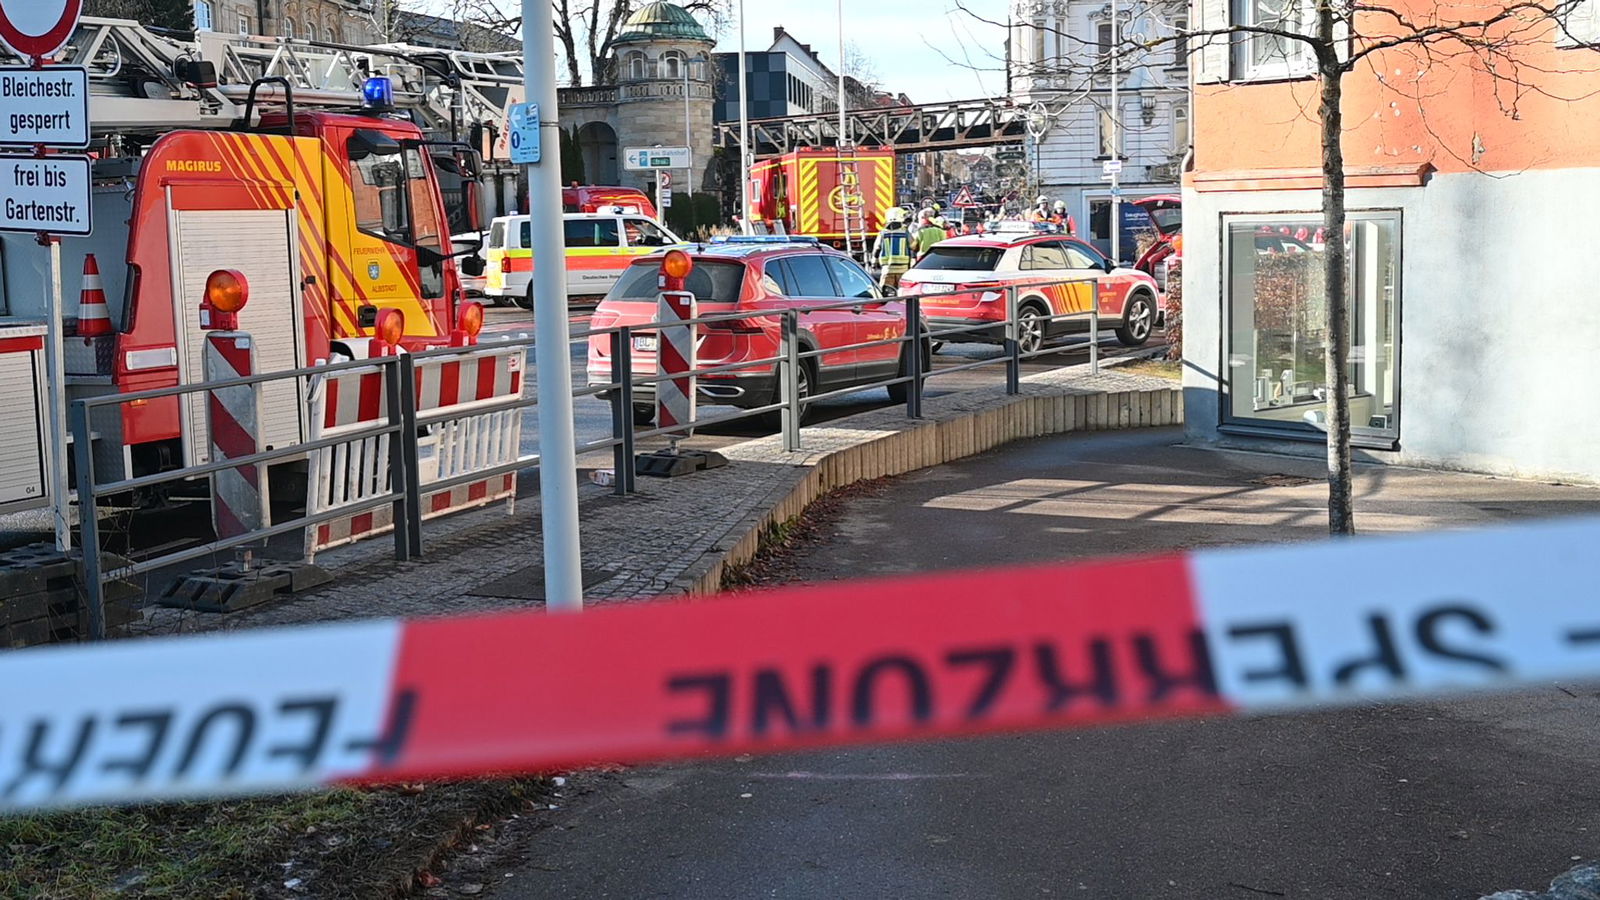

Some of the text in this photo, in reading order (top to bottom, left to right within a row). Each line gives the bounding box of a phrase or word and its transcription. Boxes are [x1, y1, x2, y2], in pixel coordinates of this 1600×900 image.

[3, 76, 76, 98] Bleichestr.
[10, 110, 71, 135] gesperrt
[14, 164, 67, 188] frei bis
[166, 160, 222, 172] MAGIRUS
[5, 198, 80, 223] Gartenstr.
[353, 247, 385, 255] FEUERWEHR
